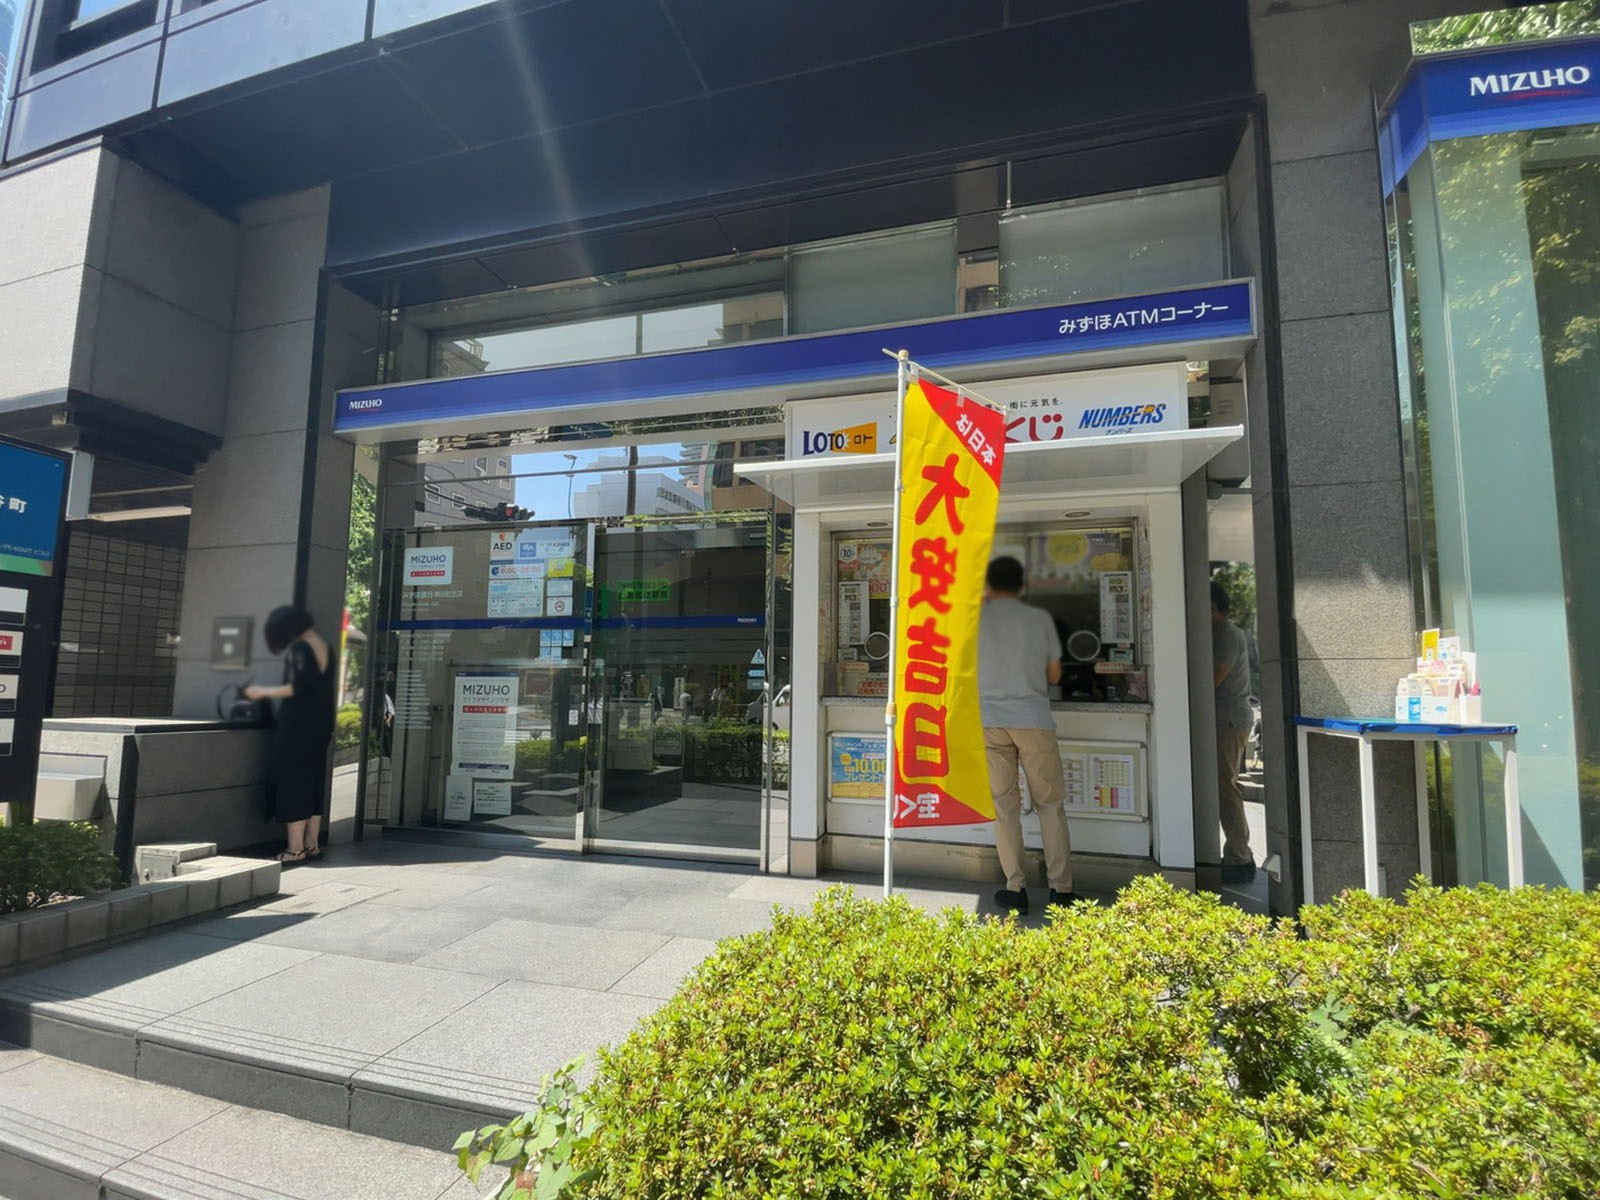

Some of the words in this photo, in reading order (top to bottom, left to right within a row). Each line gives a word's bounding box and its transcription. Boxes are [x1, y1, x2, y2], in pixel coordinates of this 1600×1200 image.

[1469, 65, 1590, 97] MIZUHO
[1058, 301, 1229, 334] みずほATMコーナー
[349, 399, 383, 410] MIZUHO
[1078, 403, 1167, 430] NUMBERS
[802, 430, 845, 456] LOTO
[853, 433, 873, 445] ロト
[492, 542, 513, 551] AED
[410, 554, 447, 564] MIZUHO
[462, 684, 511, 696] MIZUHO
